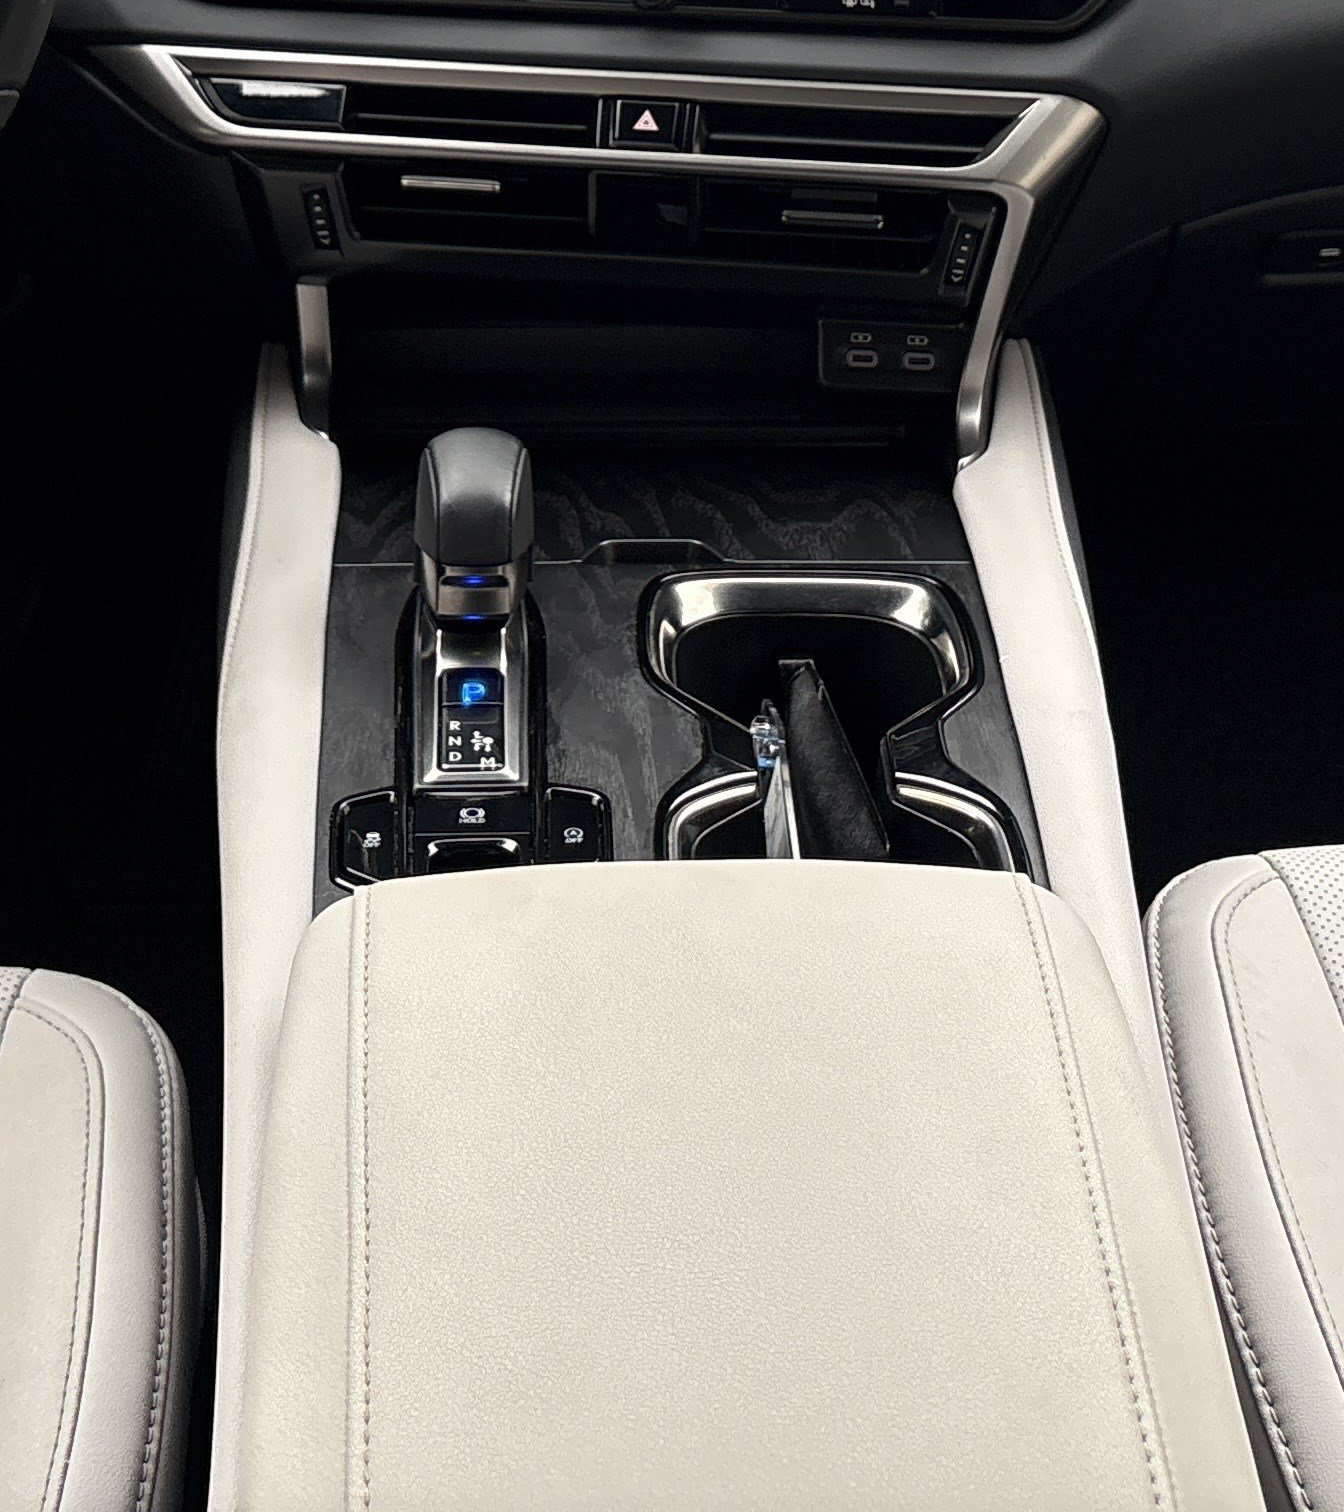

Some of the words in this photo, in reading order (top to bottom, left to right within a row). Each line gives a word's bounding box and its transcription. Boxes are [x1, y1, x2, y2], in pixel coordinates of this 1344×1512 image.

[462, 680, 487, 706] P
[448, 720, 461, 731] R
[448, 735, 462, 746] N
[448, 751, 462, 762] D
[458, 817, 486, 825] HOLD
